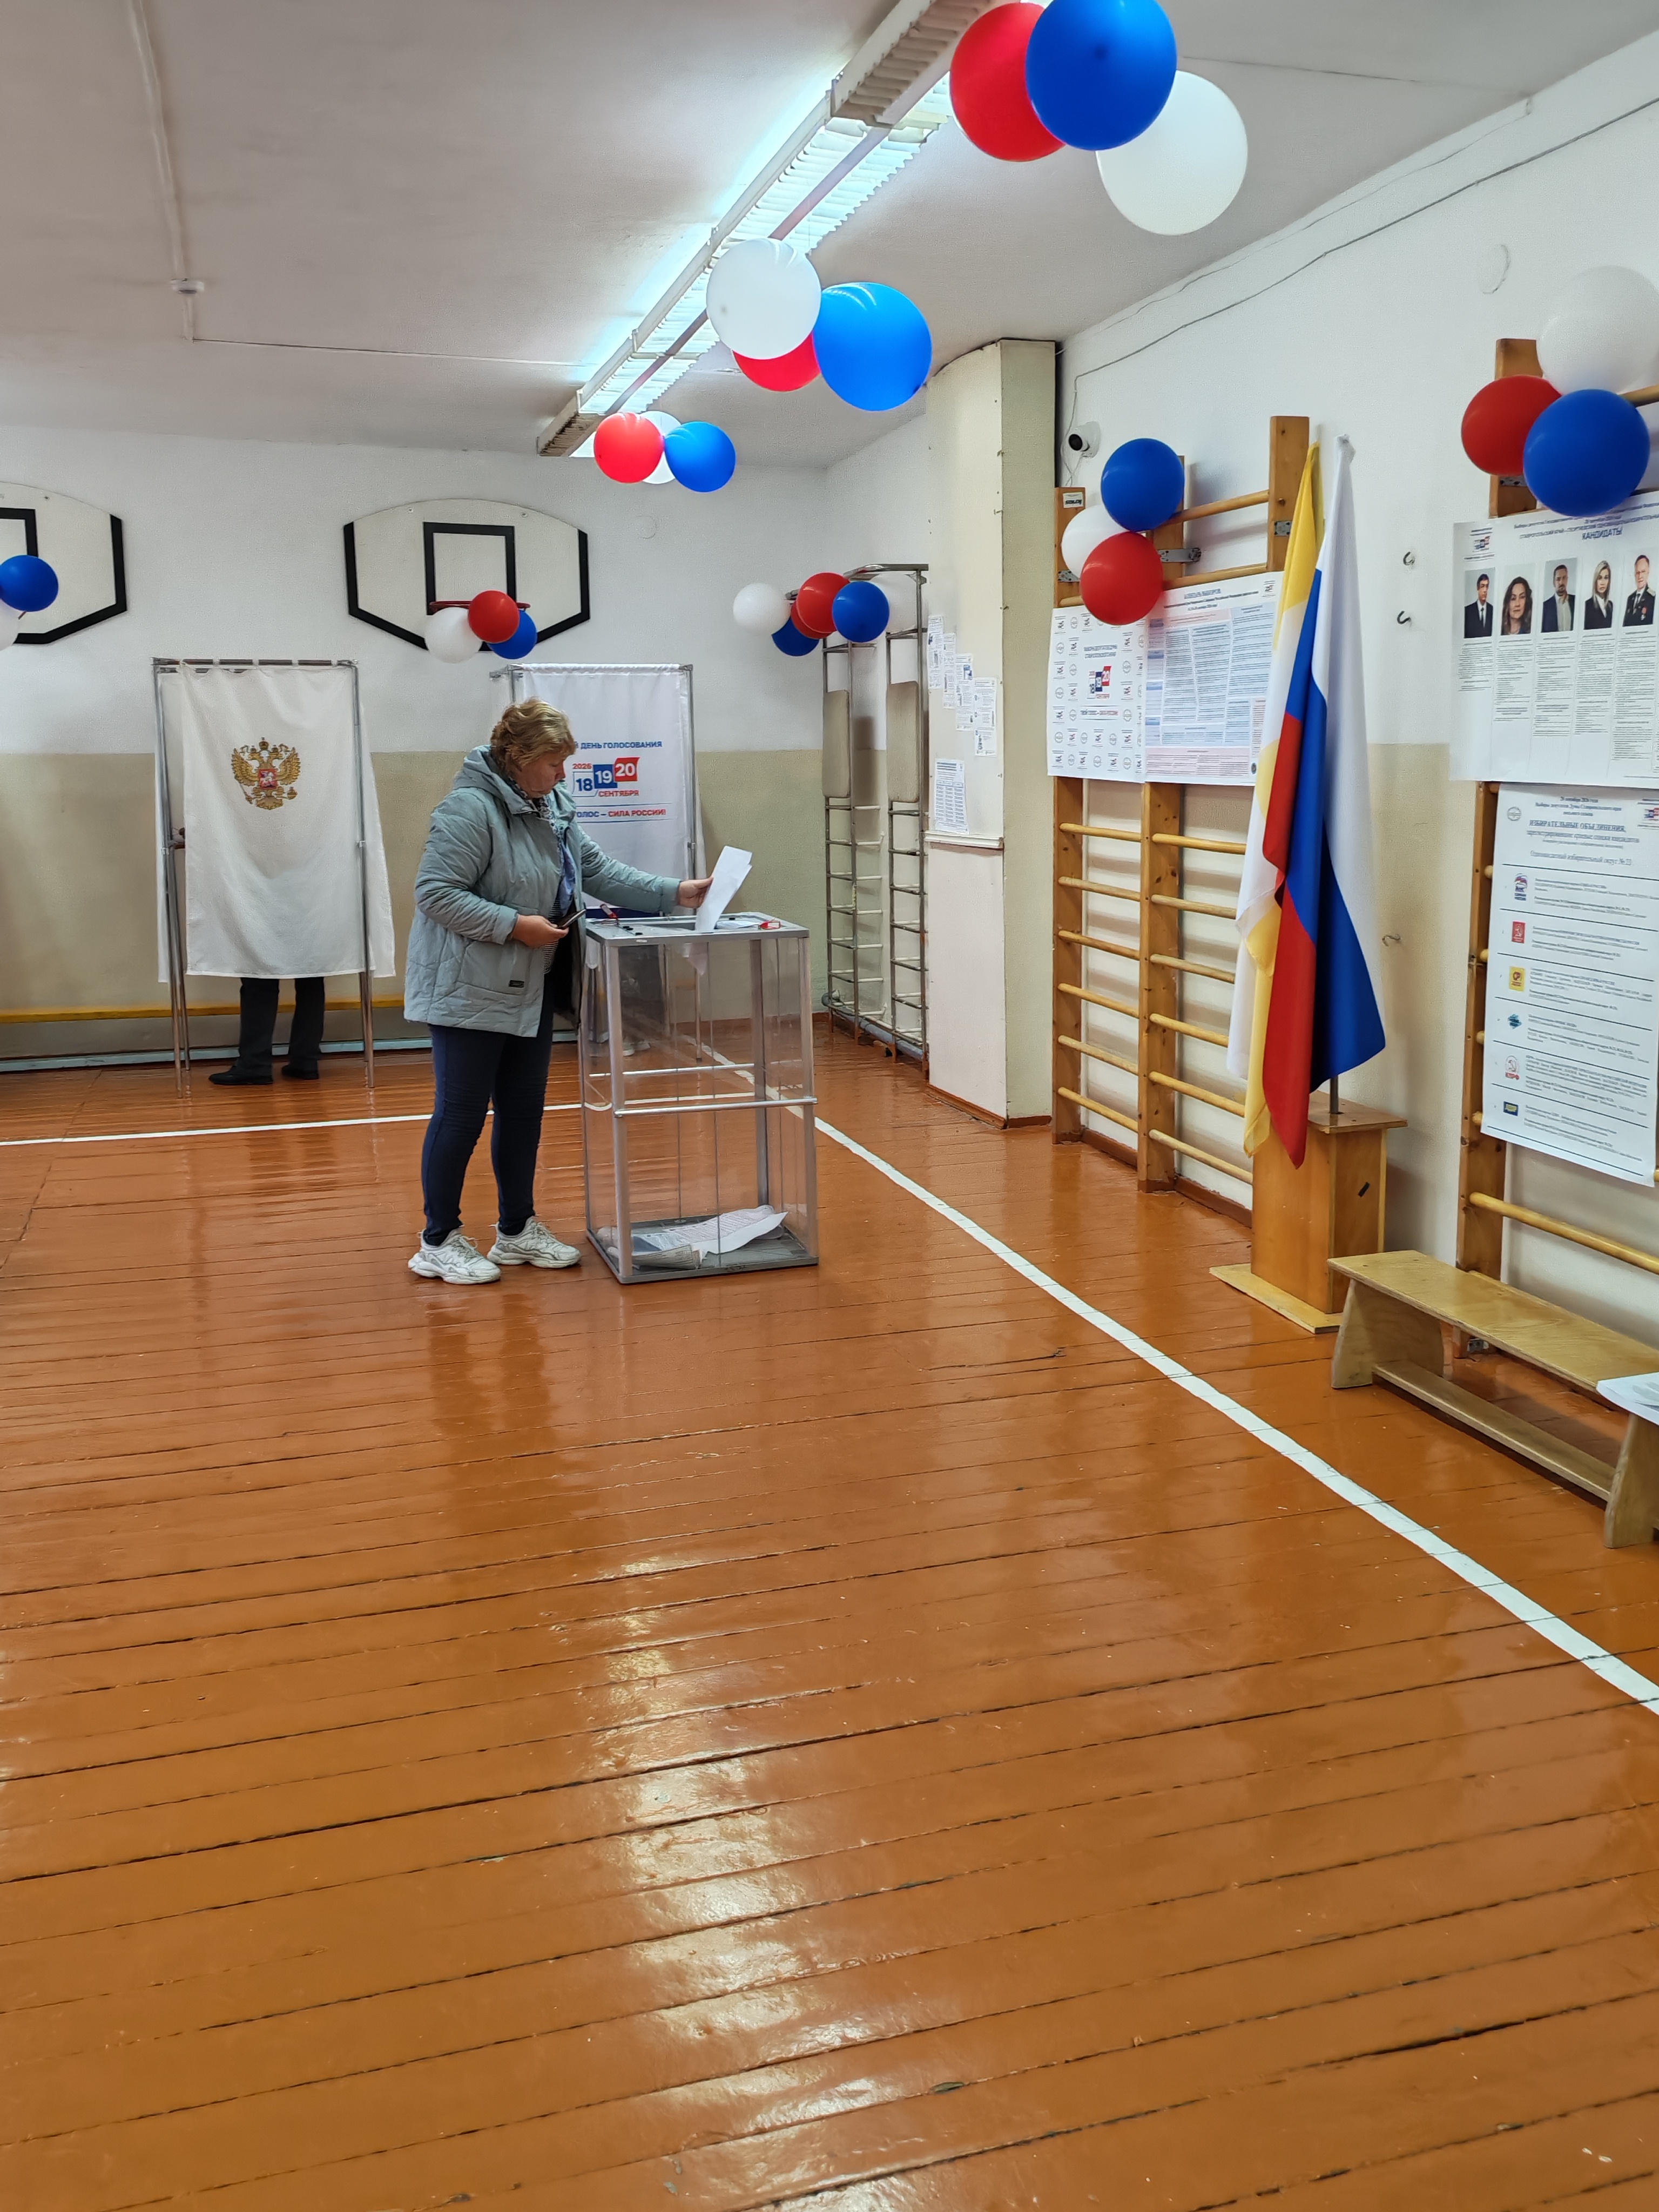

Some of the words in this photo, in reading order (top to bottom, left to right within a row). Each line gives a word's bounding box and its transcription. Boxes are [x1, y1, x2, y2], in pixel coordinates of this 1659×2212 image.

[1582, 527, 1623, 540] КАНДИДАТЫ
[576, 778, 593, 791] 18
[595, 770, 612, 784] 19
[615, 763, 636, 777] 20
